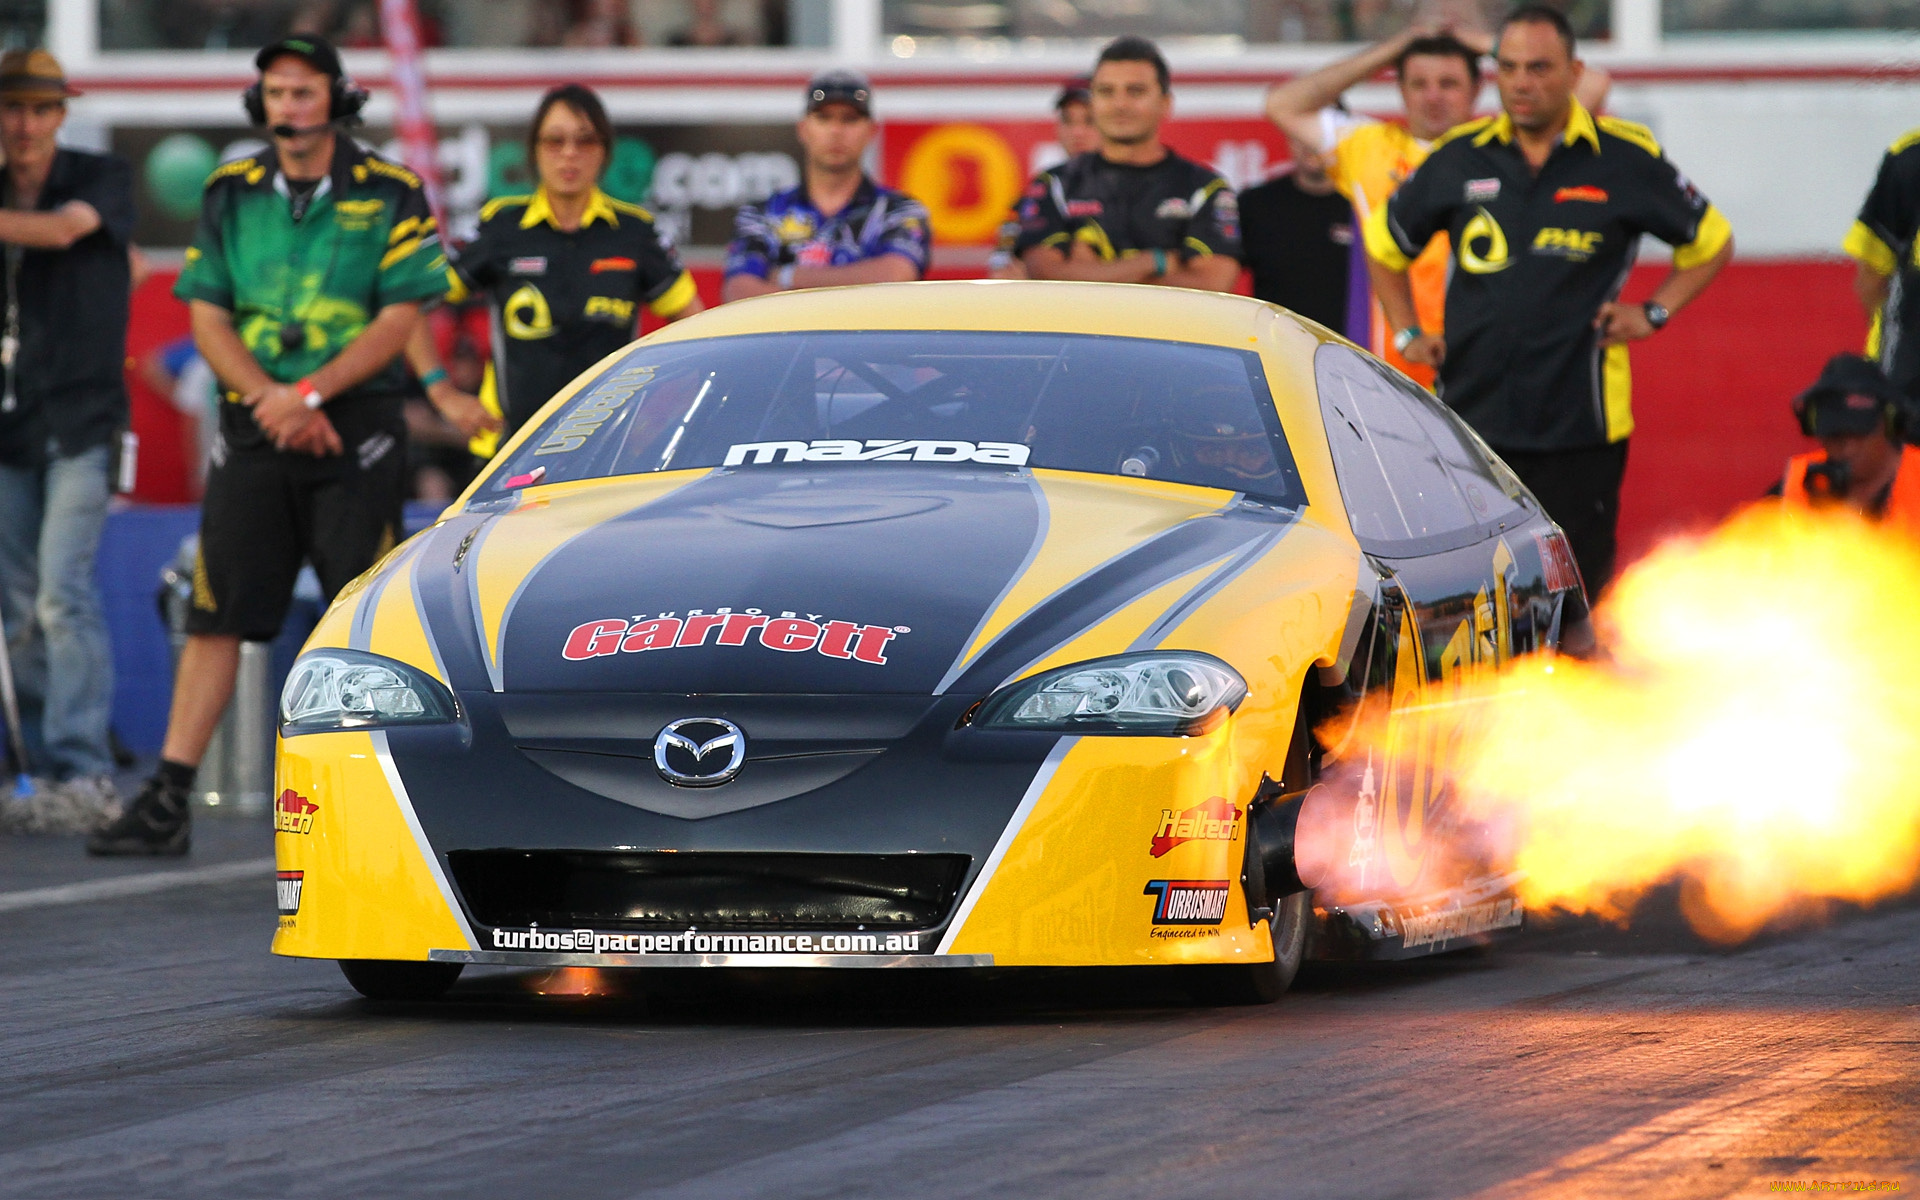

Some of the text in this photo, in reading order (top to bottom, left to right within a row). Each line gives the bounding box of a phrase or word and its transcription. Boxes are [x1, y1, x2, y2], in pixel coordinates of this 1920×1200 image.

[631, 607, 823, 622] TURBO BY
[562, 613, 896, 665] Garrett
[1157, 808, 1241, 841] Haltech
[1149, 881, 1229, 920] TURBOSMART
[492, 928, 919, 955] turbos@pacperformance.com.au
